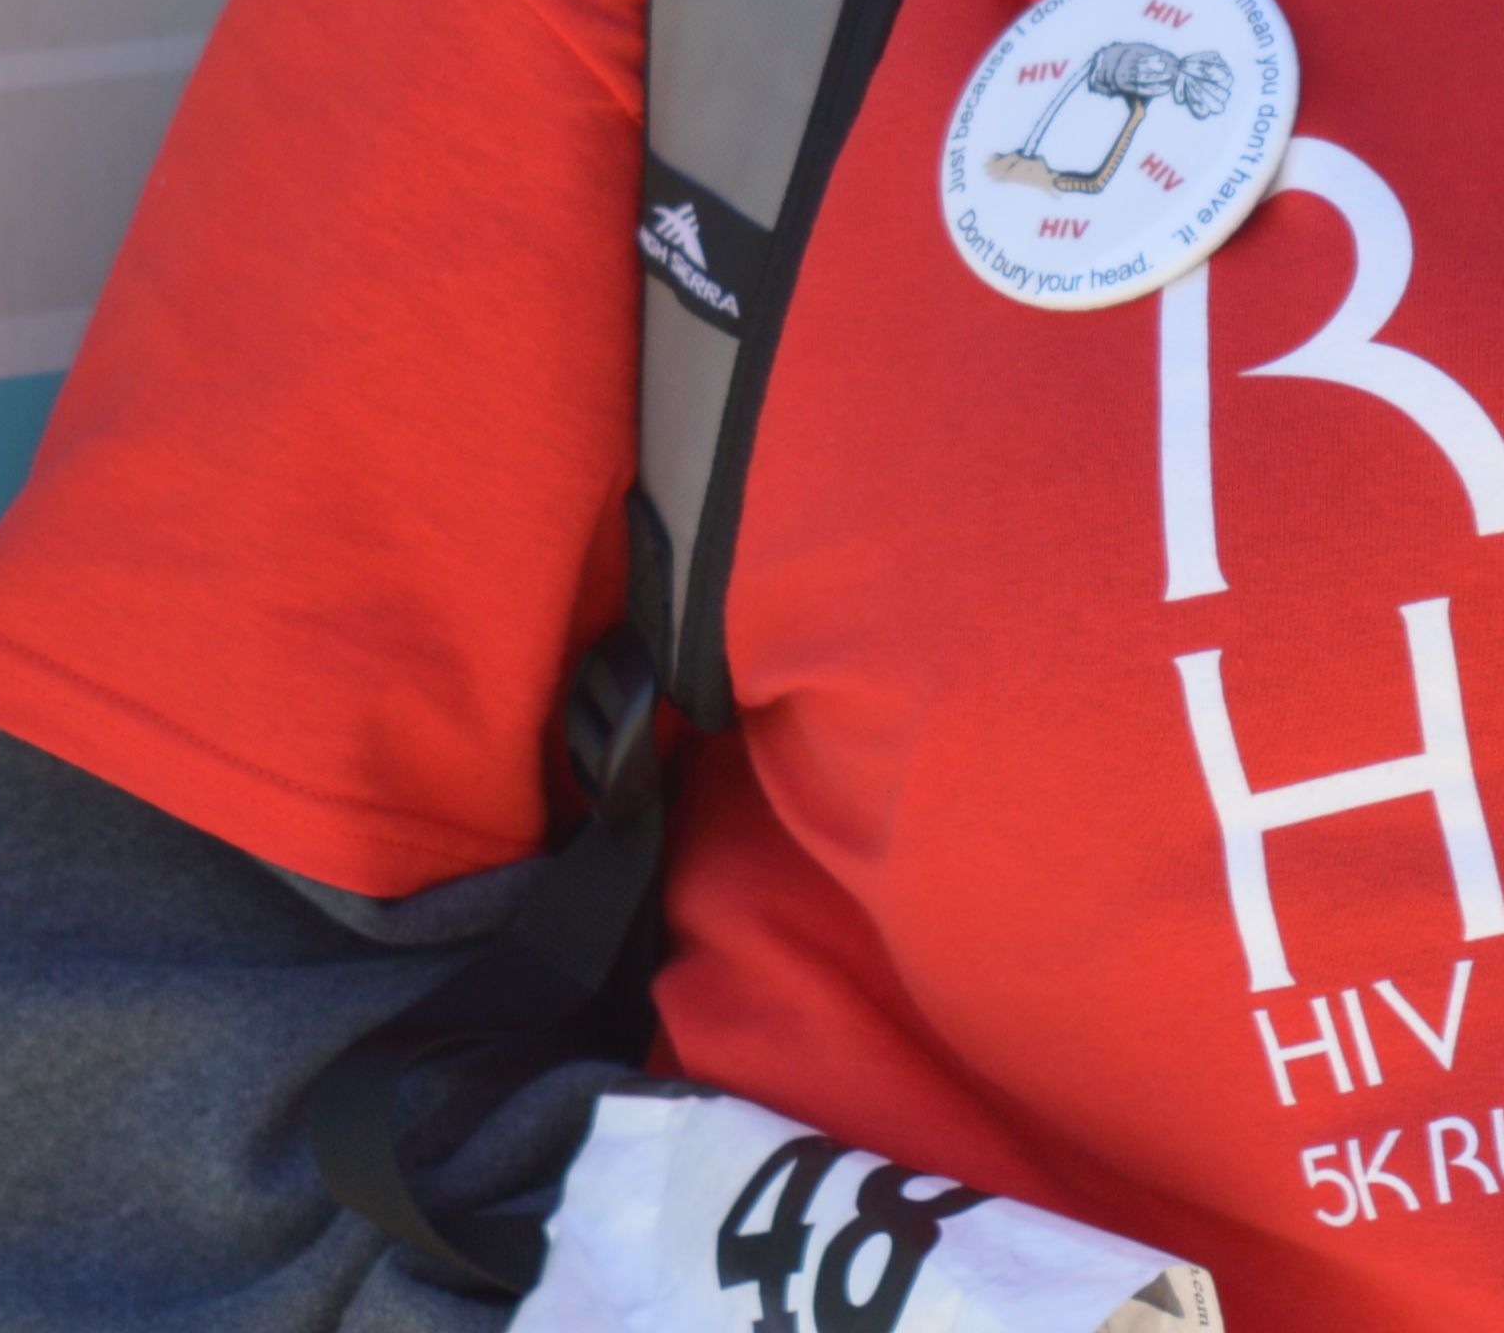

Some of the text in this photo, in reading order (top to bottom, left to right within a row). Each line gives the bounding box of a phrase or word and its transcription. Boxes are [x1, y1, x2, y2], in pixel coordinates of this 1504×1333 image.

[951, 40, 1014, 140] because
[1017, 58, 1070, 85] HIV
[1255, 51, 1280, 96] you
[1240, 102, 1277, 165] don't
[948, 146, 967, 193] Just
[1138, 152, 1186, 193] HIV
[1196, 167, 1252, 225] have
[956, 208, 1156, 296] Don't bury your head.
[1037, 216, 1092, 240] HIV
[1299, 1129, 1421, 1228] 5K
